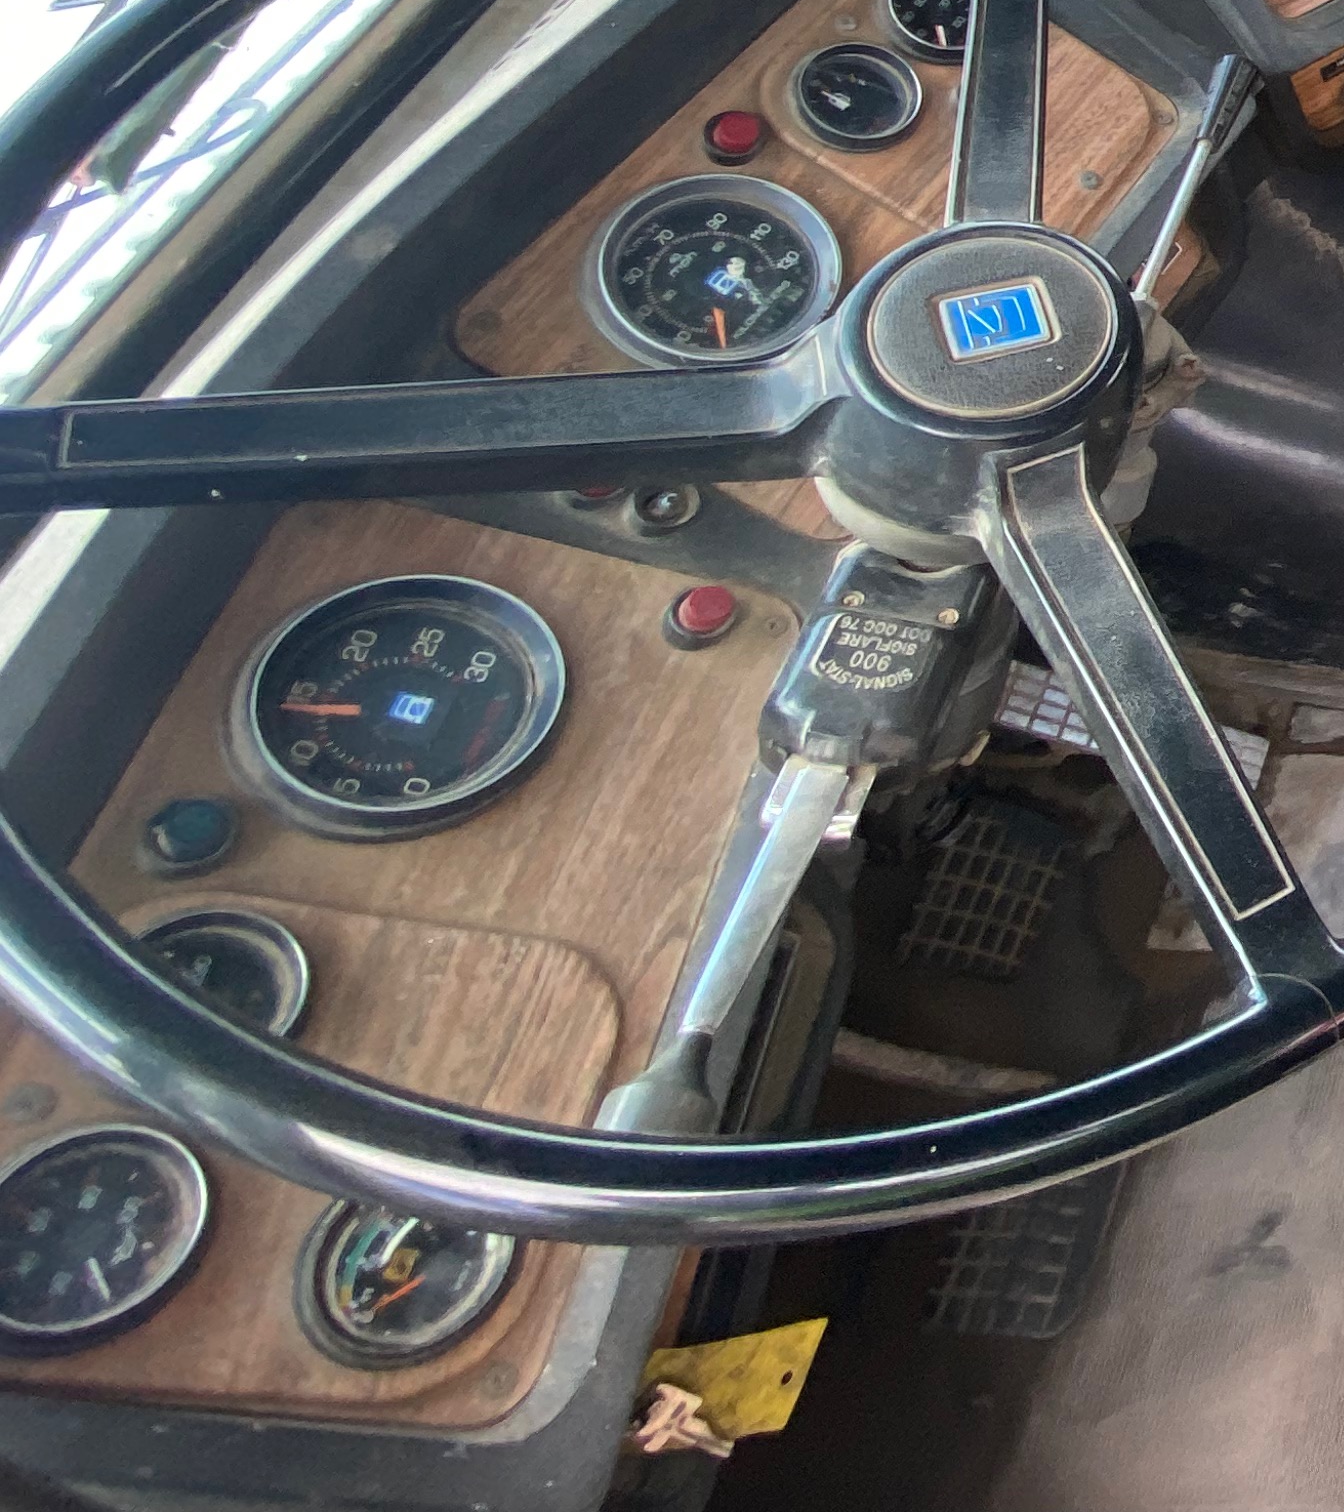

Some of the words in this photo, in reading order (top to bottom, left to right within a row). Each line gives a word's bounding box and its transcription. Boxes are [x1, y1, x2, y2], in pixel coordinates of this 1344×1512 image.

[653, 229, 674, 246] 70
[840, 615, 860, 630] 76
[341, 629, 378, 662] 20
[411, 626, 446, 657] 25
[837, 631, 917, 656] SIGFLARE
[463, 650, 497, 683] 30
[849, 650, 892, 671] 900
[819, 659, 914, 689] SIGNAL-STAT
[334, 777, 361, 795] 5
[403, 777, 431, 795] 0
